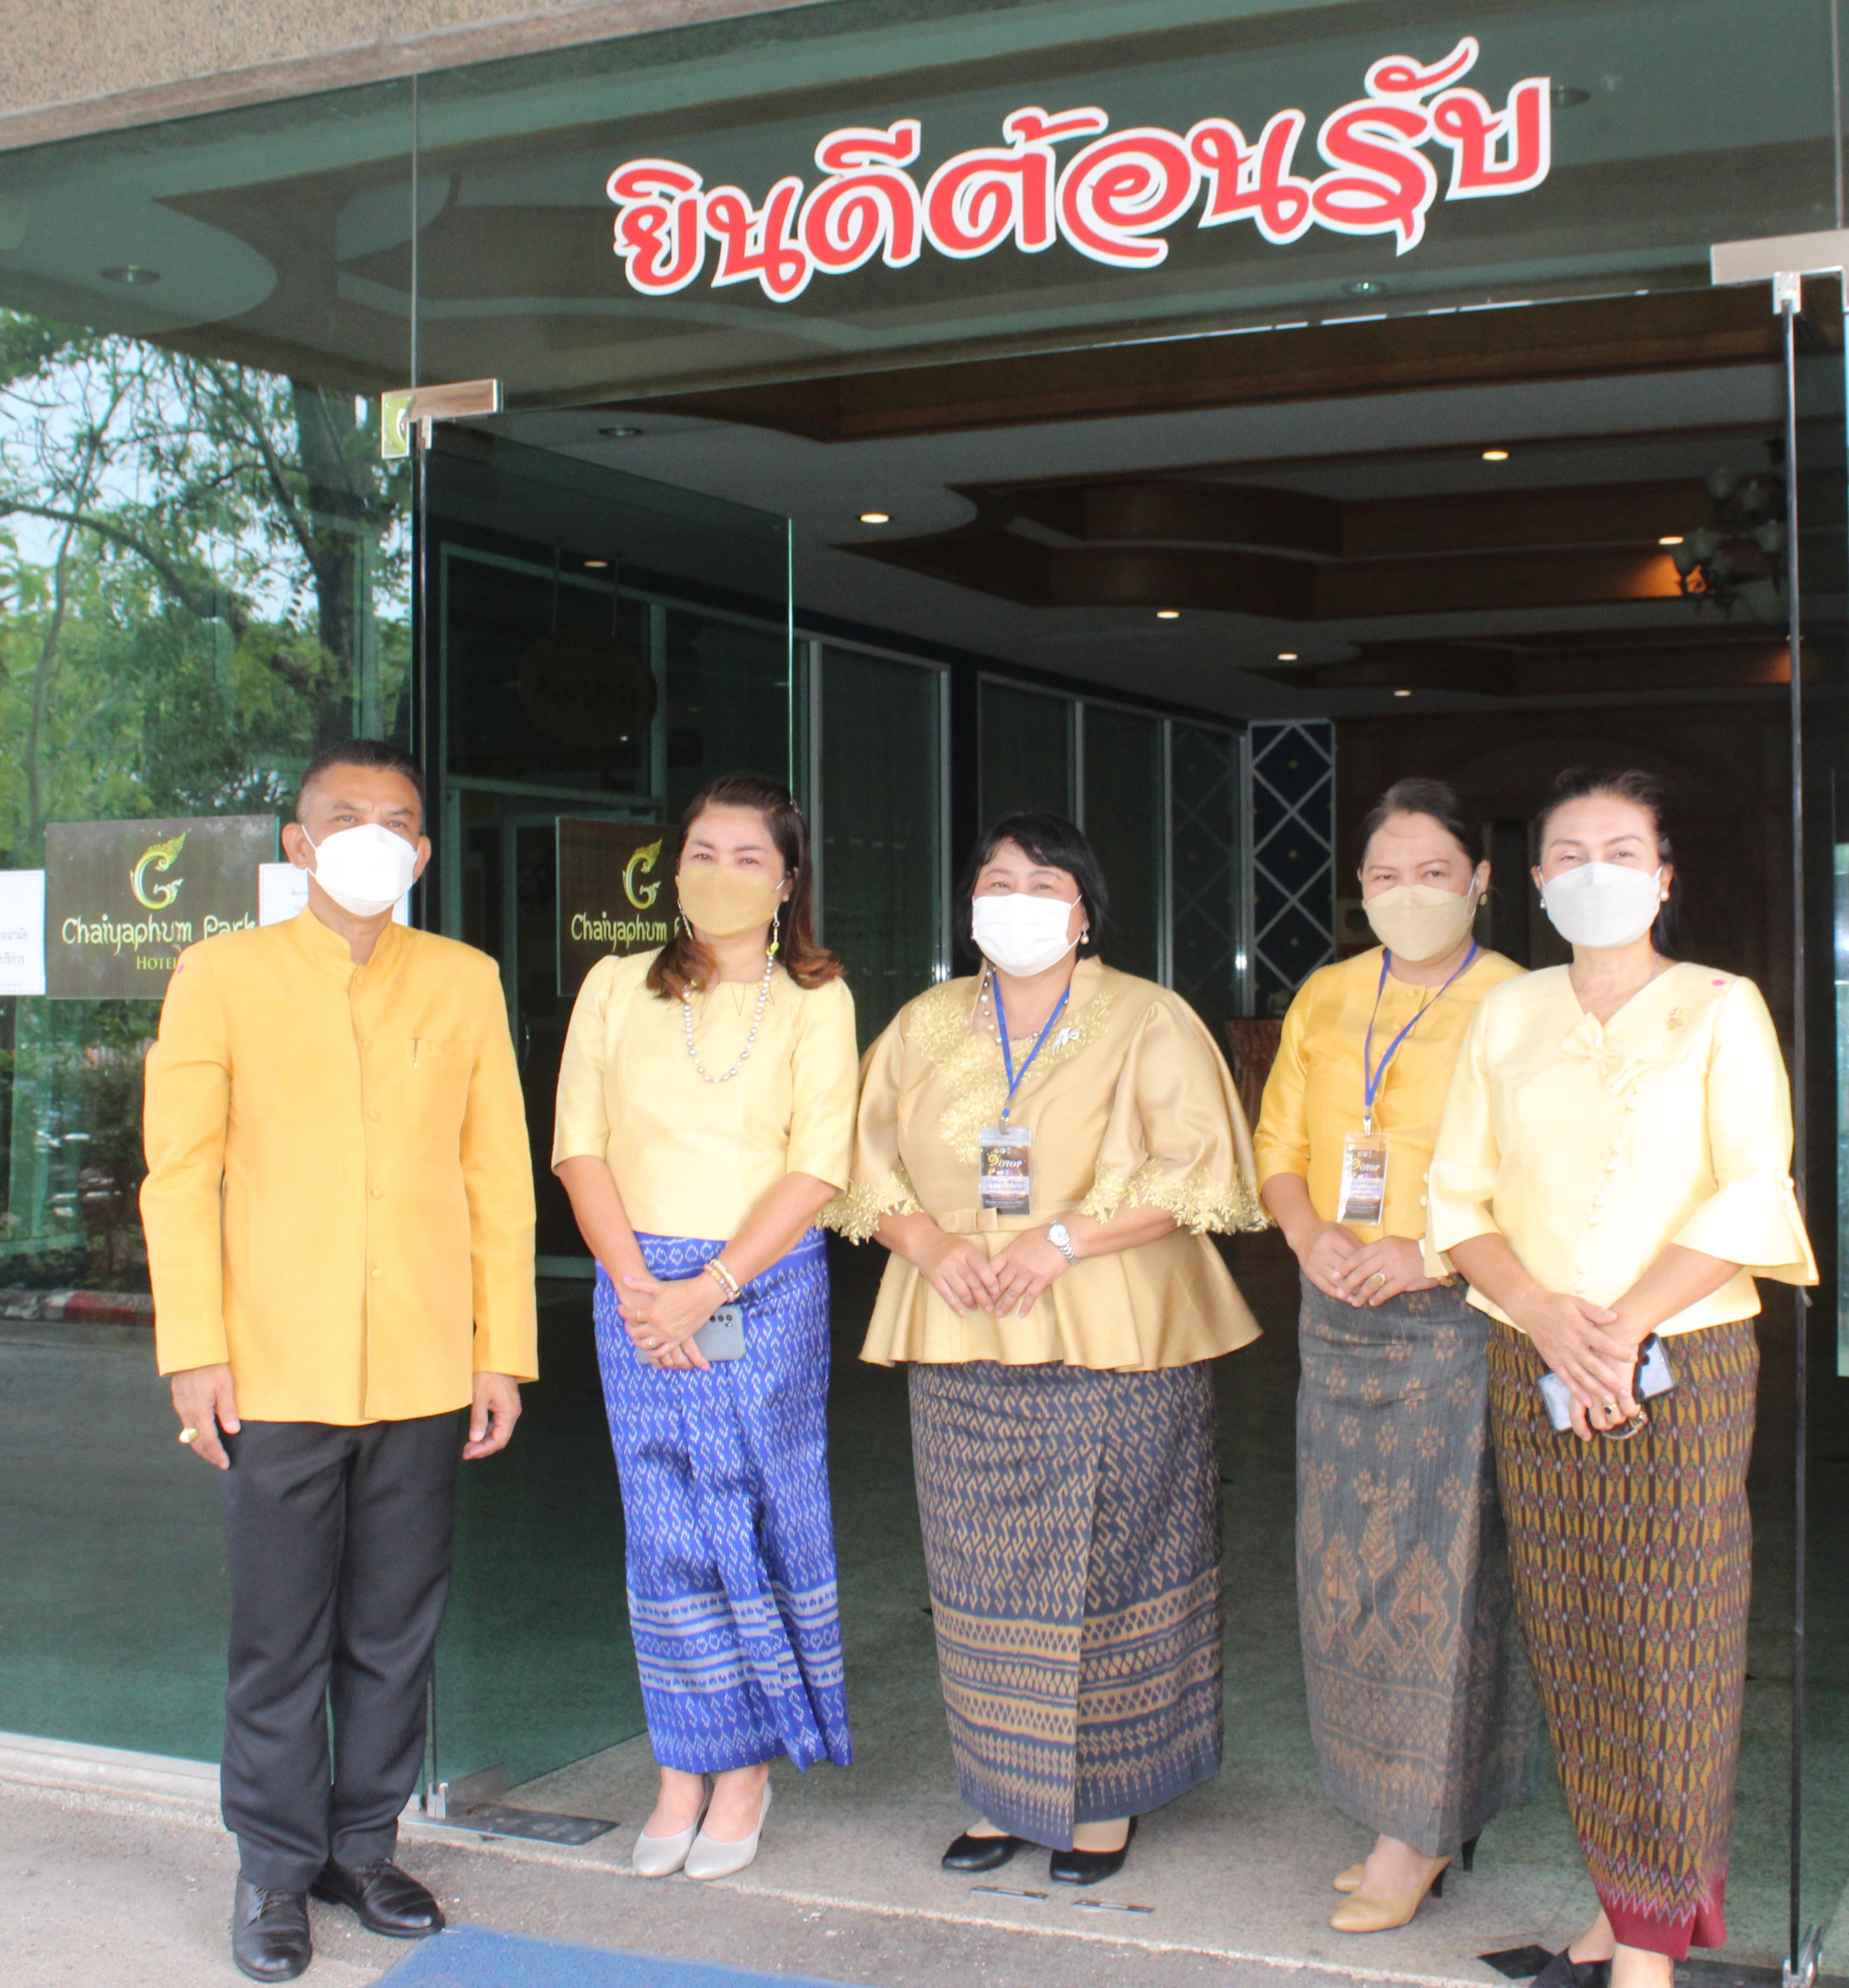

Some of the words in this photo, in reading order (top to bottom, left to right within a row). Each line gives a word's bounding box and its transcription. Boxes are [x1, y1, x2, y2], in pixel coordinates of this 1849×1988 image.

[607, 38, 1550, 301] ยินดีต้อนรับ
[0, 927, 28, 940] อนามัย
[61, 913, 193, 956] Chaiyaphum
[570, 911, 668, 953] Chaiyaphum
[998, 1160, 1023, 1168] OTOP
